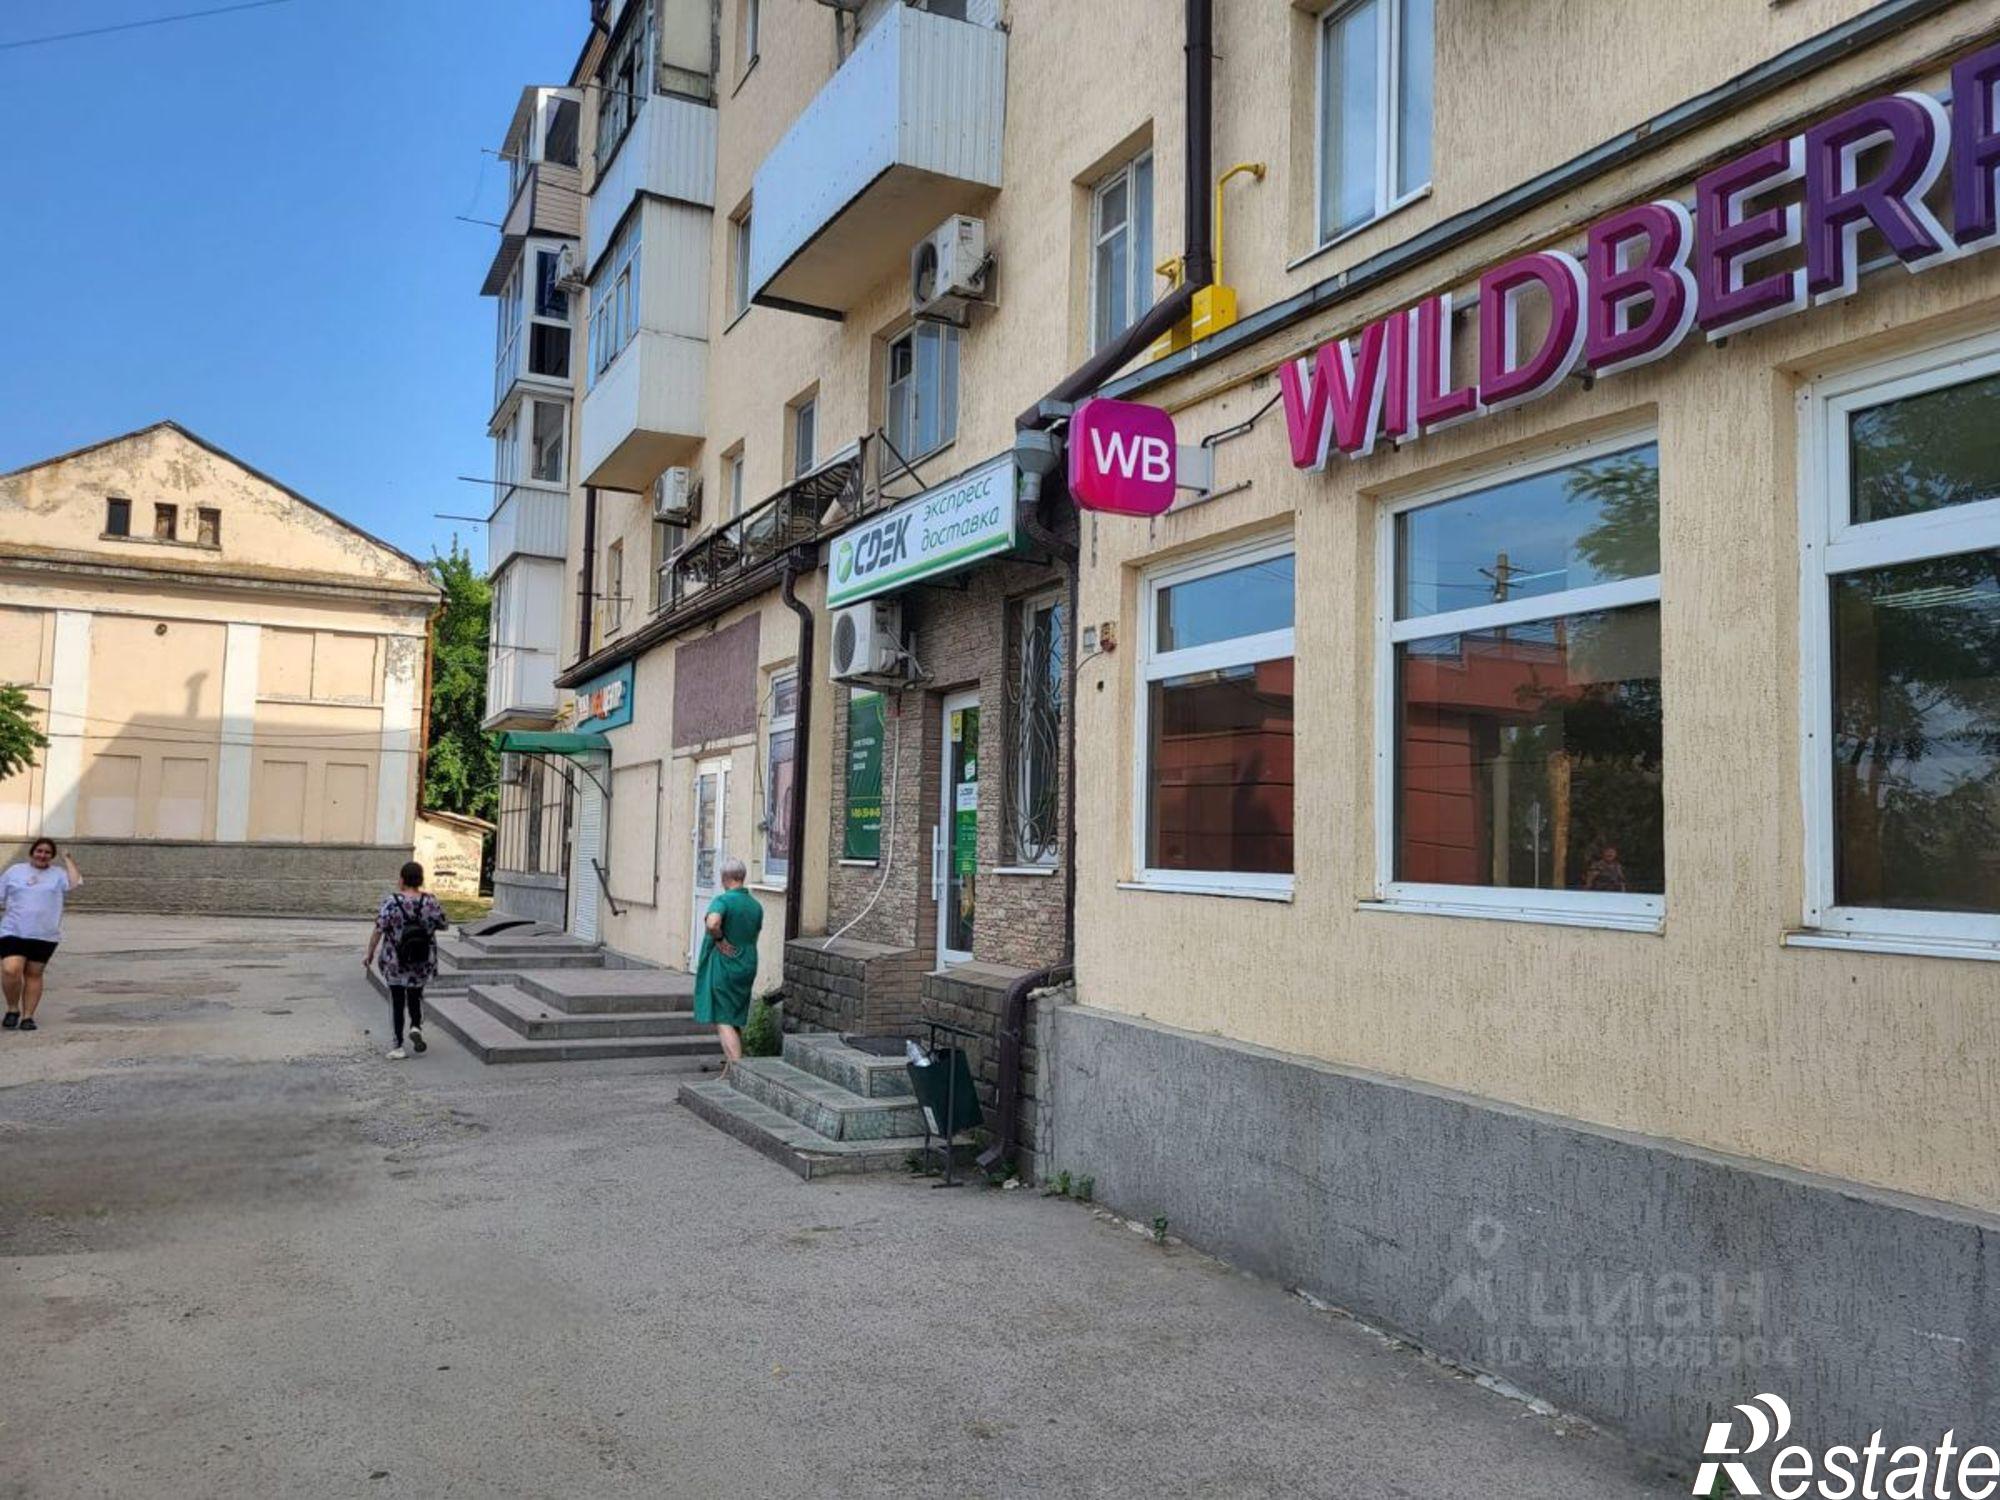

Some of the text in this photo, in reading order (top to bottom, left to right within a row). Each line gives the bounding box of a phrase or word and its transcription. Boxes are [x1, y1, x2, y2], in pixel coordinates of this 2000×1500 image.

[1091, 428, 1171, 483] WB
[922, 475, 993, 523] экспресс
[921, 504, 1000, 552] доставка
